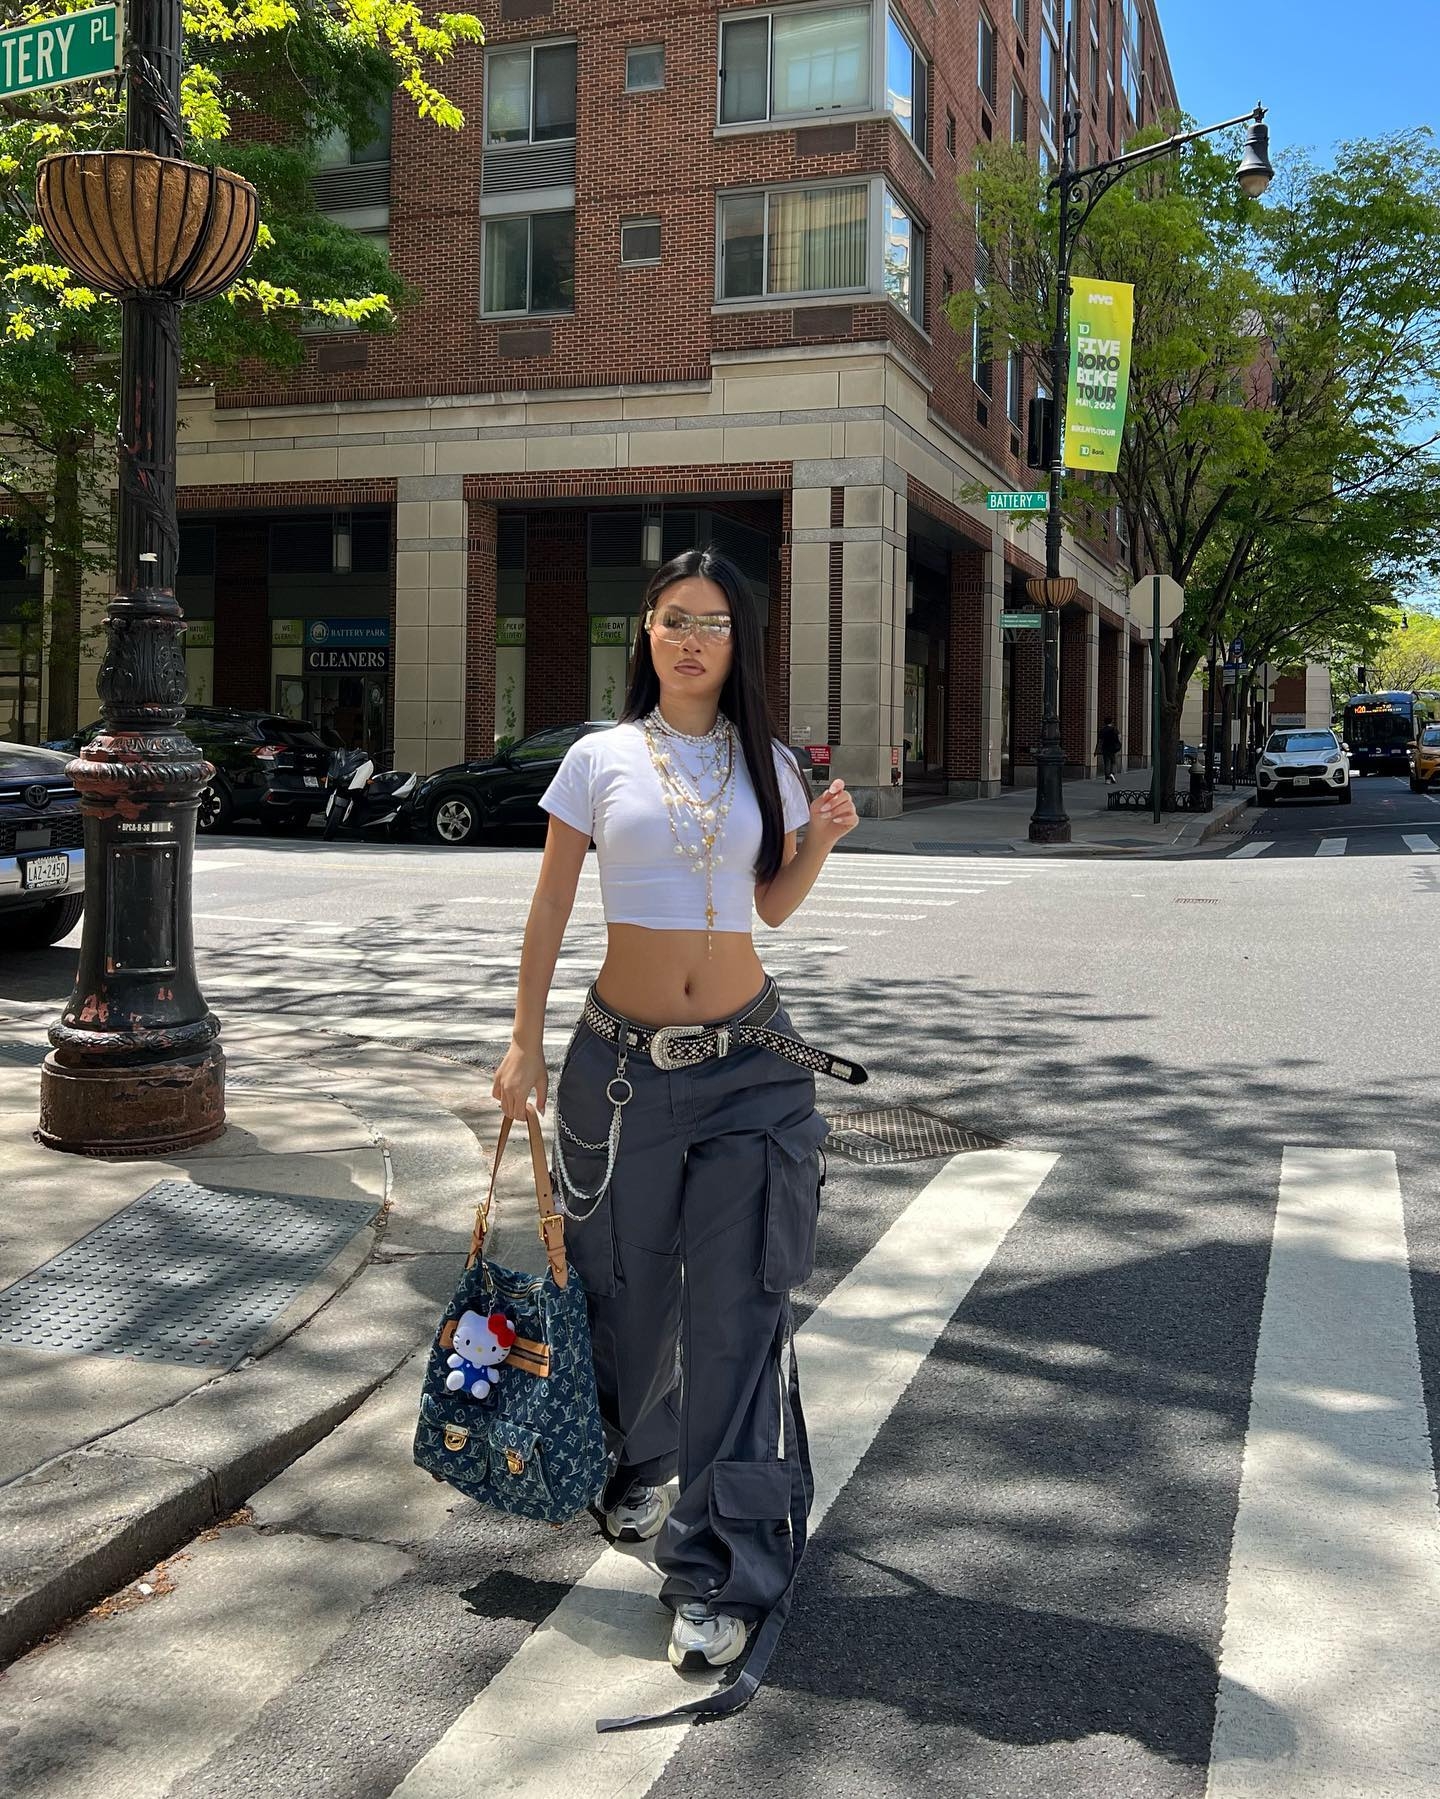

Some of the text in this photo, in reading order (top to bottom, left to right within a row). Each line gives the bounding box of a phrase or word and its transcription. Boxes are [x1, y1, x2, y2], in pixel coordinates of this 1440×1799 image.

[2, 16, 113, 88] TERY PL
[1088, 294, 1113, 306] NYC
[1077, 336, 1121, 357] FIVE
[1077, 351, 1120, 371] BORO
[1076, 367, 1119, 388] BIKE
[1076, 382, 1117, 403] TOUR
[1094, 401, 1116, 410] 2024
[990, 494, 1046, 508] BATTERY PL
[331, 629, 386, 637] BATTERY PARK
[612, 622, 625, 630] DAY
[598, 631, 622, 639] SERVICE
[309, 651, 386, 668] CLEANERS
